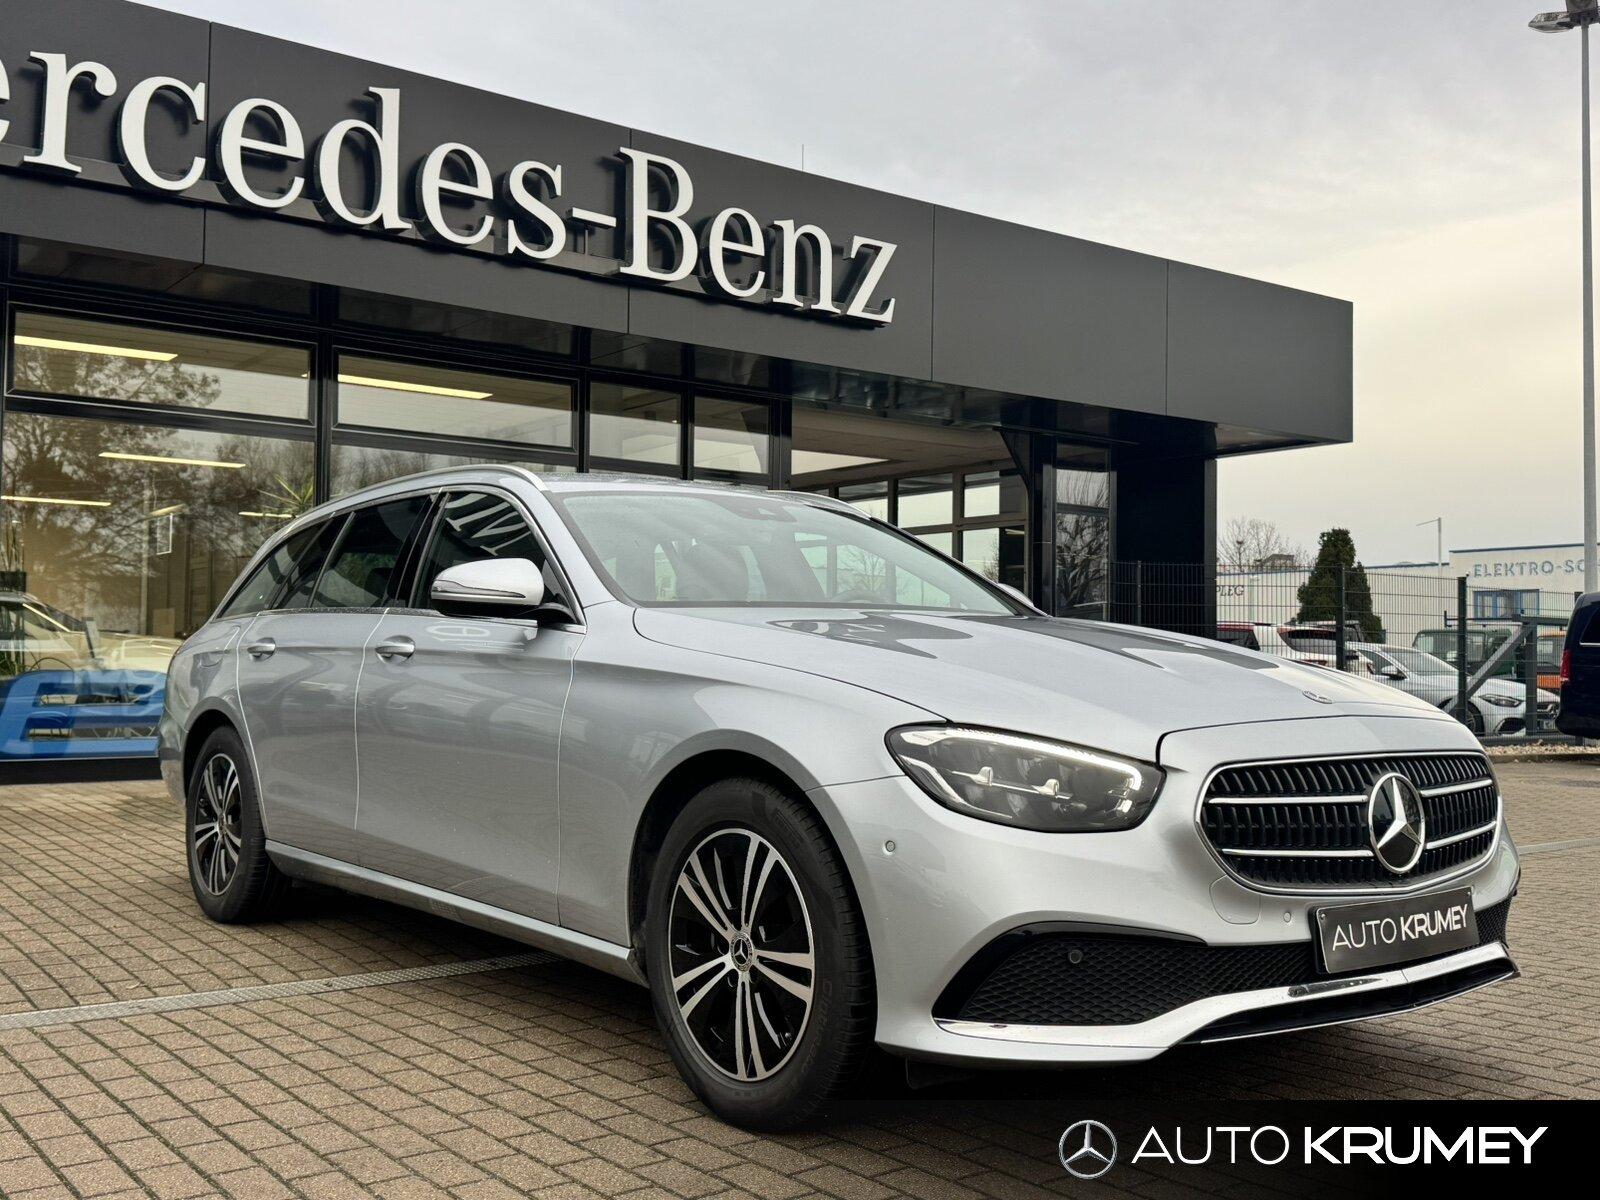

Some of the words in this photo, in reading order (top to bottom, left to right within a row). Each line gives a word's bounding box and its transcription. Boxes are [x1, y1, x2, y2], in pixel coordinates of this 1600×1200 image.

[0, 50, 898, 324] rcedes-Benz
[1474, 559, 1600, 578] ELEKTRO-SC
[1332, 917, 1398, 952] AUTO
[1400, 903, 1469, 942] KRUMEY
